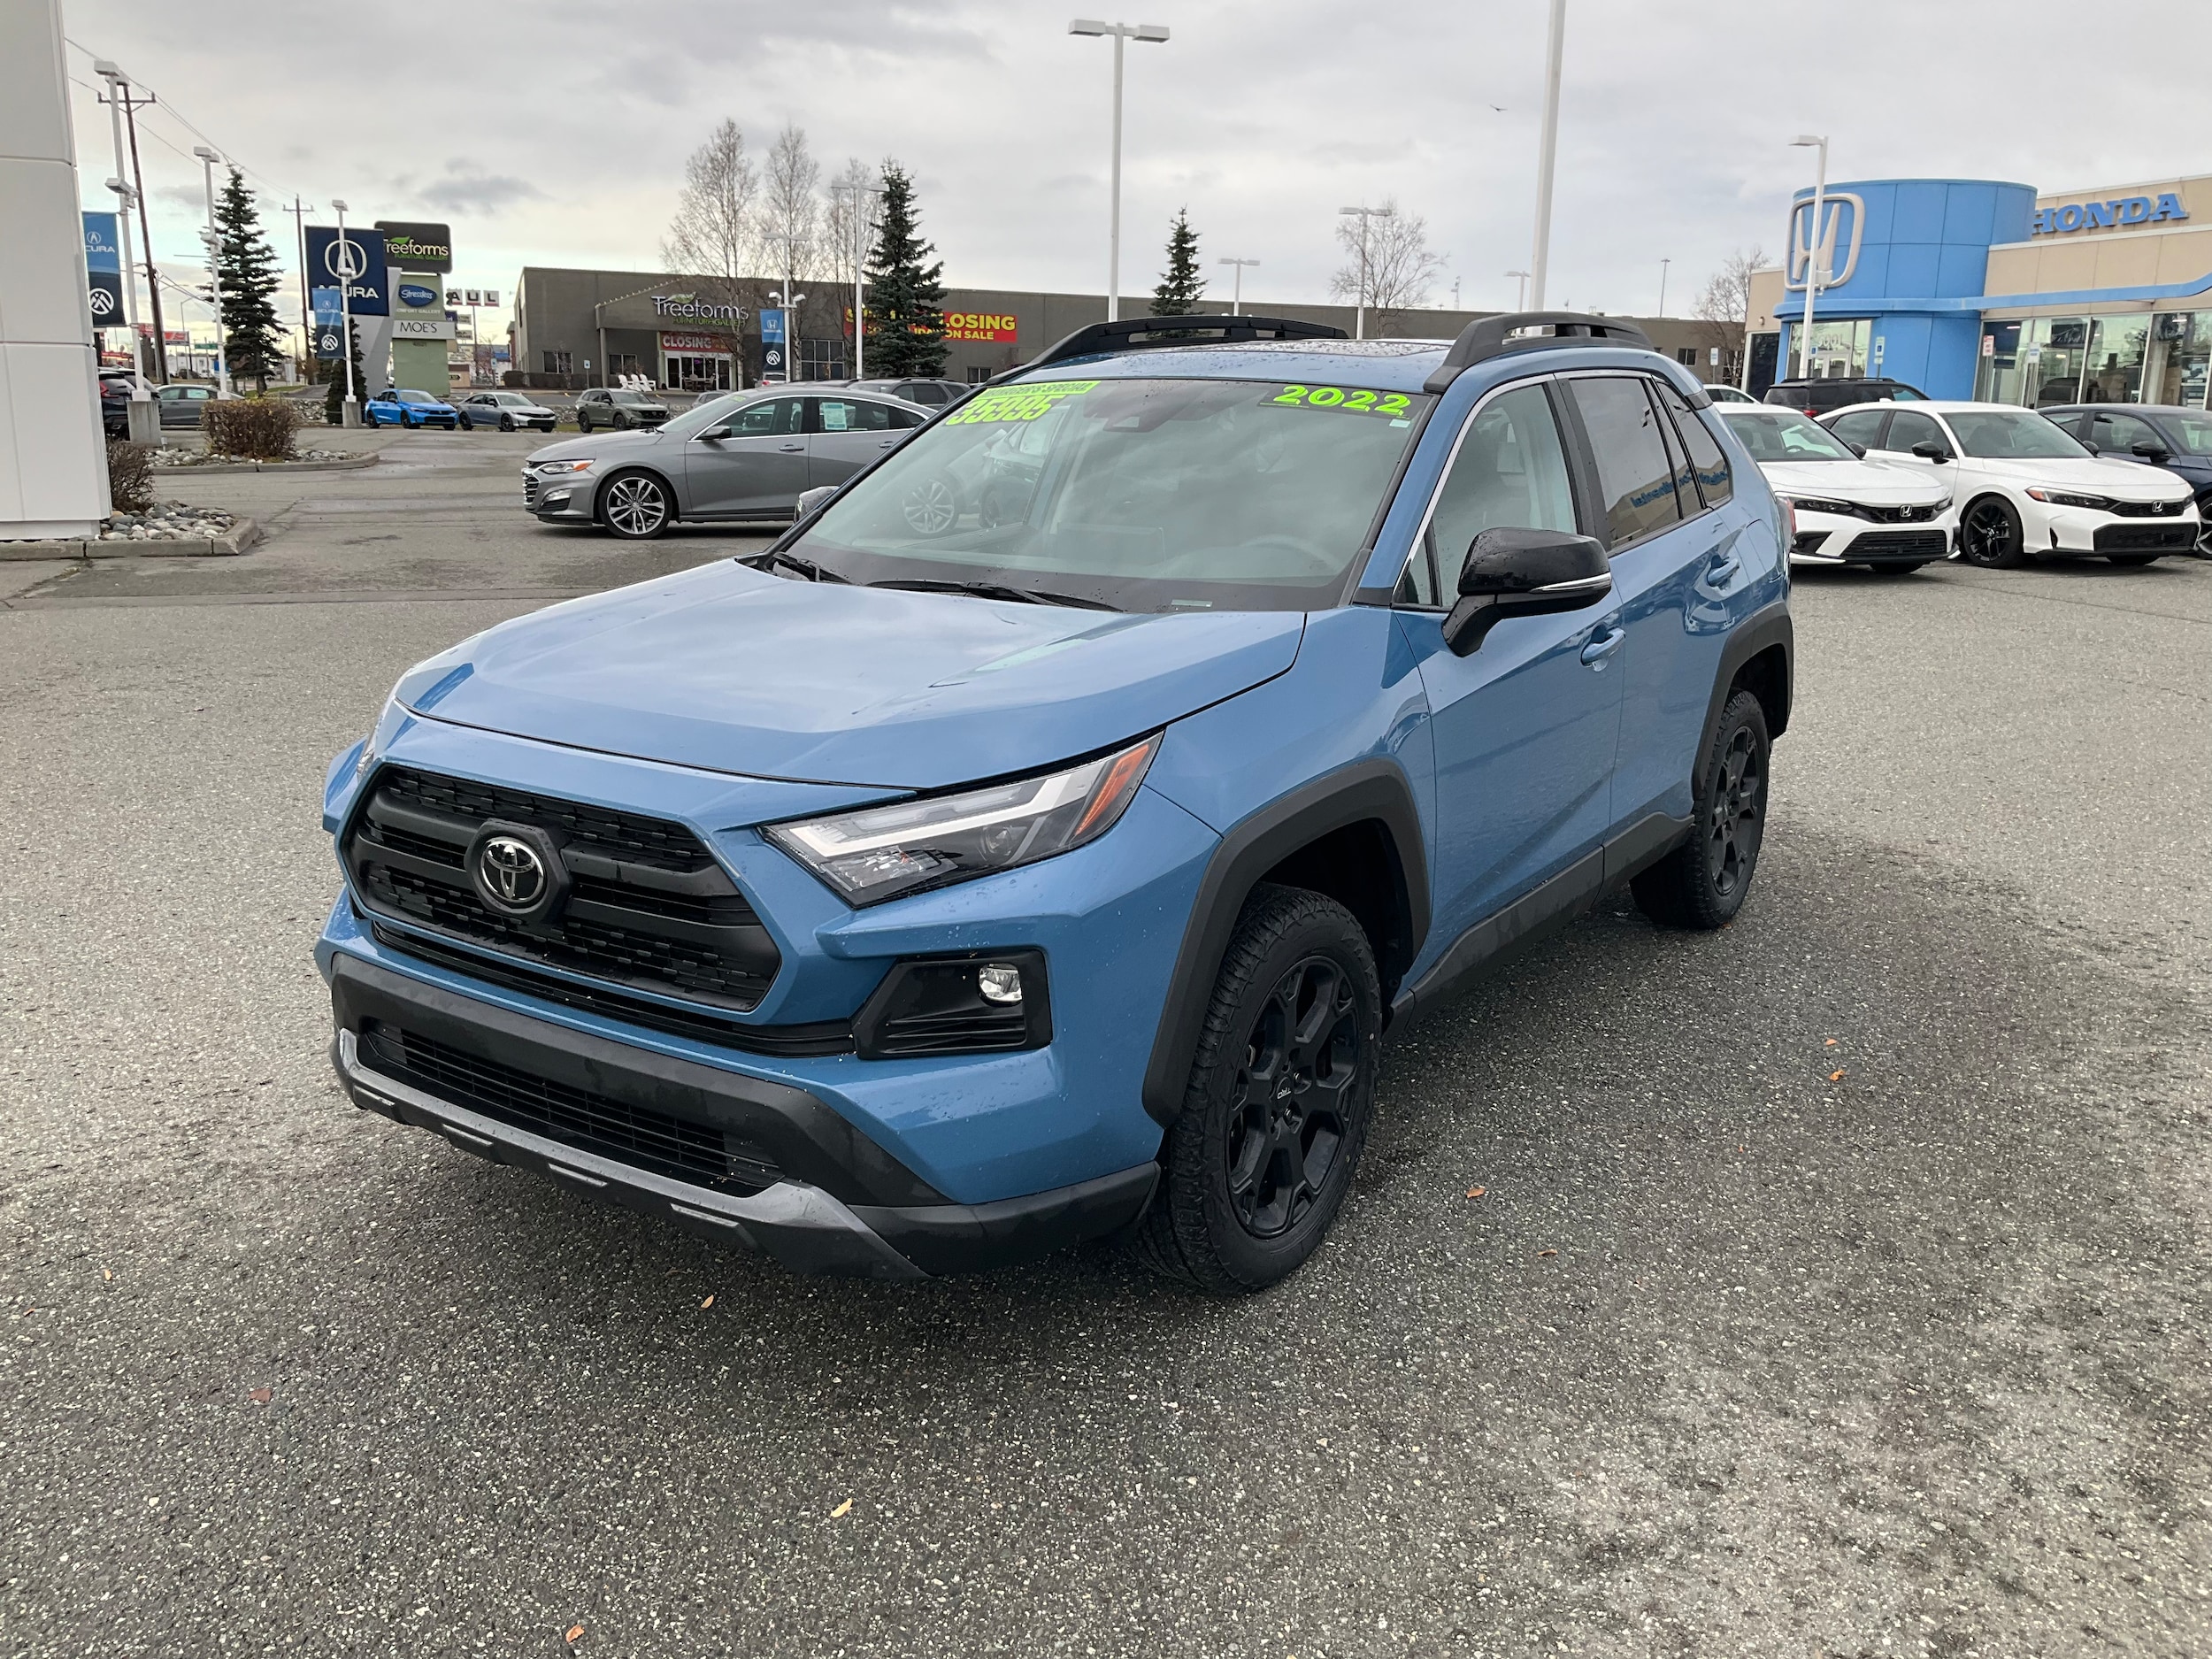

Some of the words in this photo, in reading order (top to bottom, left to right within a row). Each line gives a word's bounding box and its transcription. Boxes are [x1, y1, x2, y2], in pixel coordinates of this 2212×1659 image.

[2032, 193, 2188, 234] HONDA
[318, 285, 379, 299] URA
[650, 296, 749, 320] Treeforms
[400, 321, 437, 334] MOE'S
[964, 330, 995, 341] SALE
[663, 334, 712, 349] CLOSING
[1272, 385, 1411, 416] 2022
[945, 395, 1066, 426] 35995
